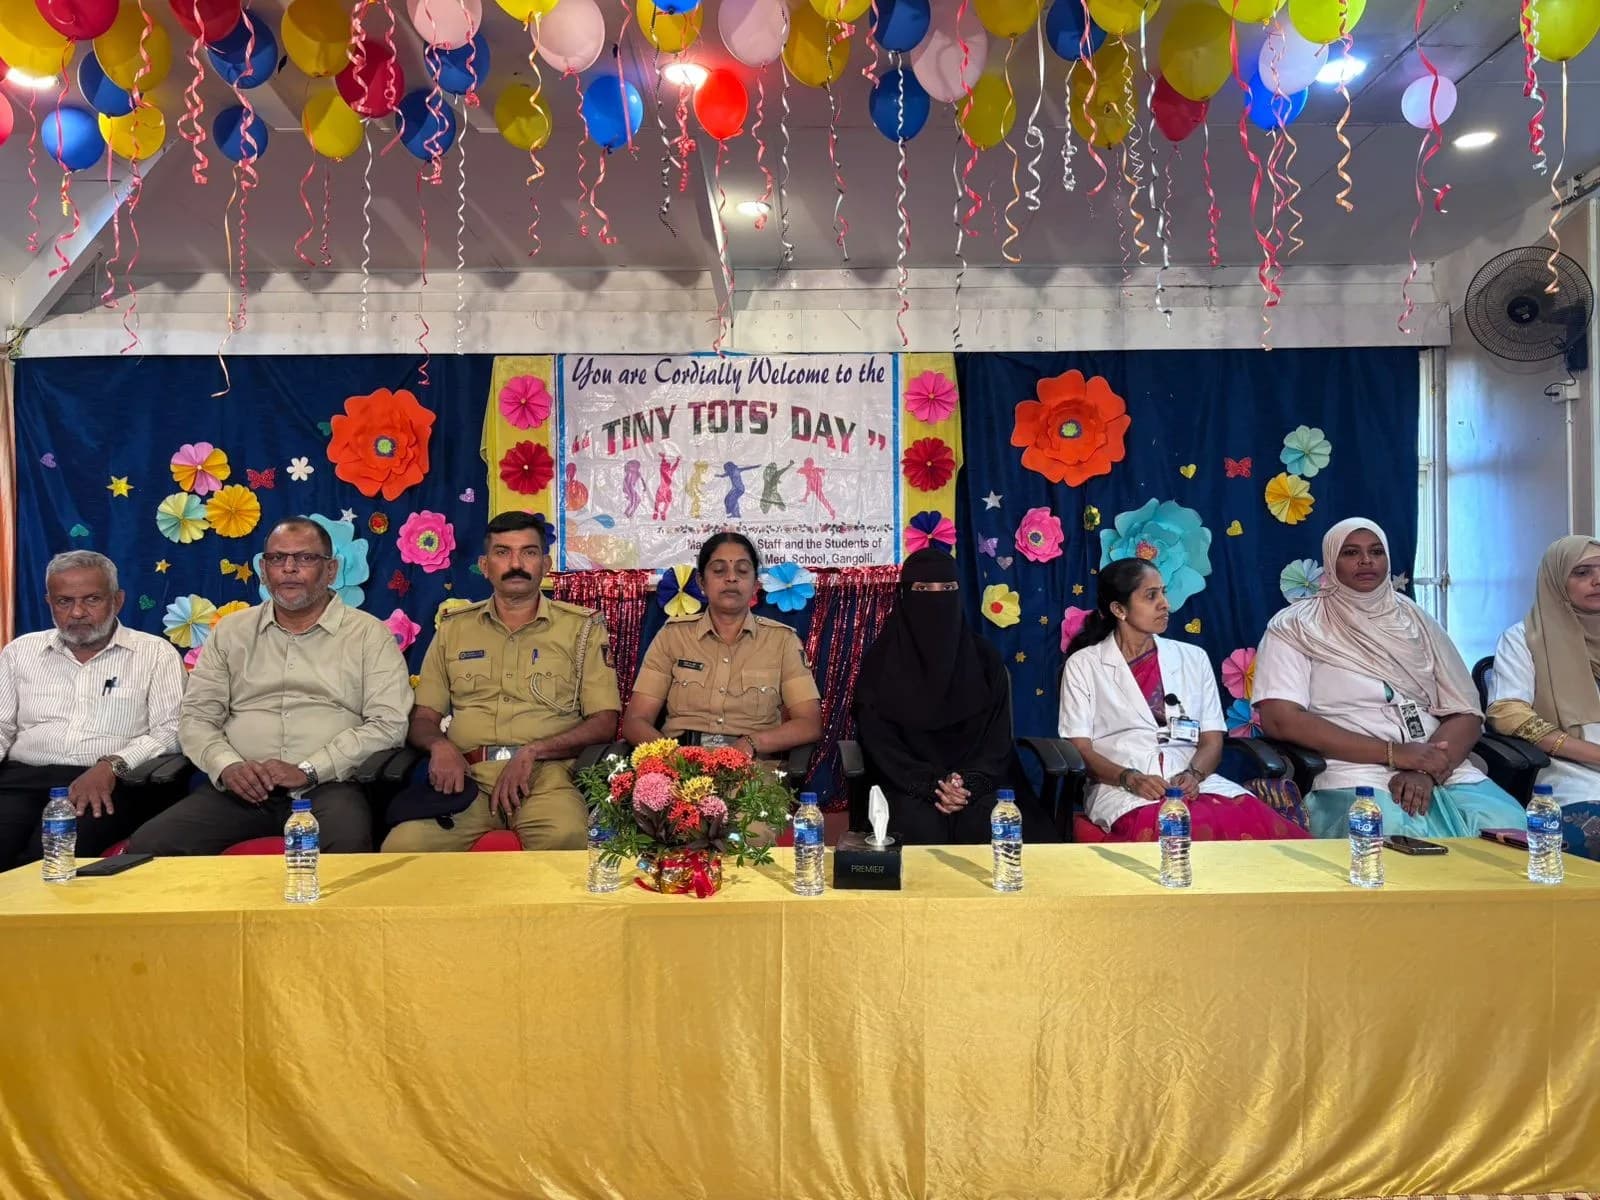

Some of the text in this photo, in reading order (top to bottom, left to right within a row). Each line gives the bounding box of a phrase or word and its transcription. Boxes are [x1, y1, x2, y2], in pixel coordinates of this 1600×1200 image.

[571, 355, 885, 394] You are Cordially Welcome to the
[601, 404, 677, 456] TINY
[790, 405, 857, 454] DAY
[757, 537, 883, 550] Staff and the Students of
[791, 552, 829, 566] School,
[831, 552, 876, 566] Gangolli.
[850, 864, 886, 874] PREMIER
